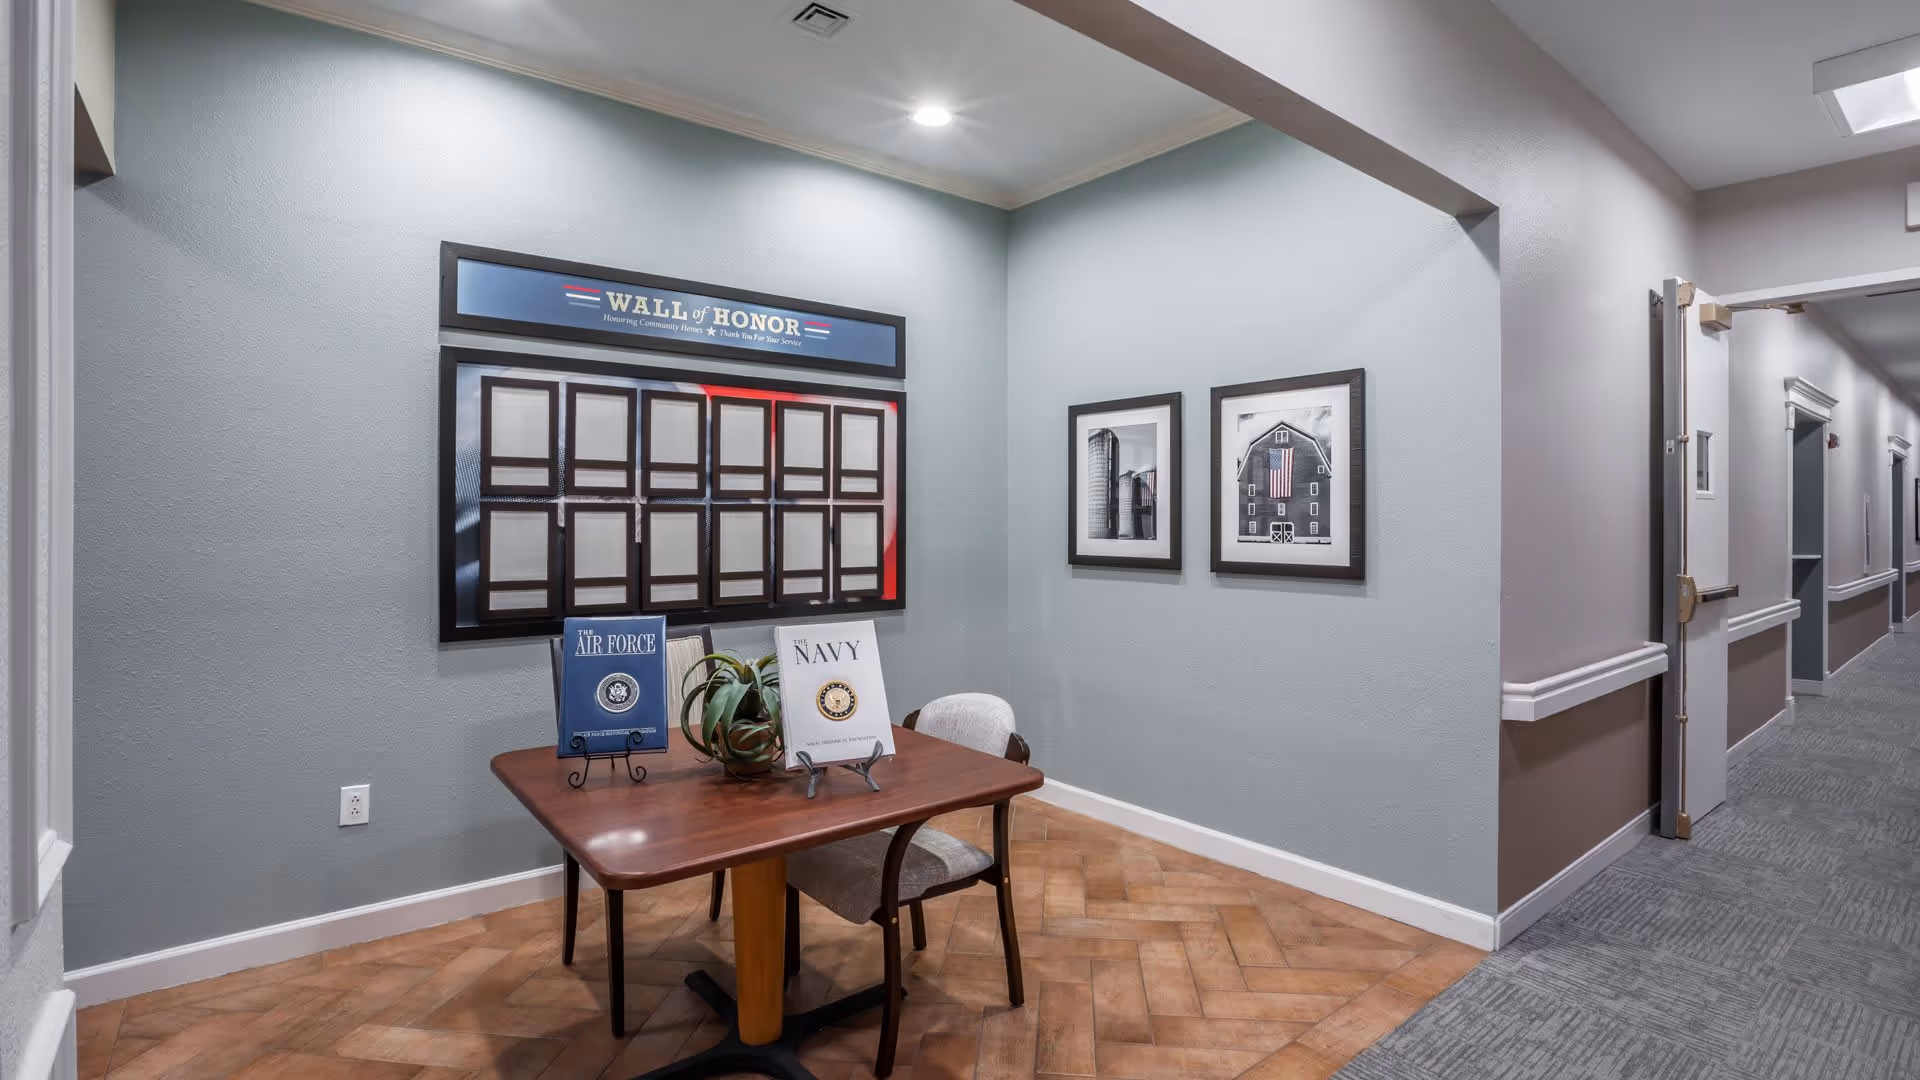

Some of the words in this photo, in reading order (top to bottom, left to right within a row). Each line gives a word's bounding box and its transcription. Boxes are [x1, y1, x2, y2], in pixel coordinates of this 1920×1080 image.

[603, 313, 638, 327] Honoring
[639, 319, 680, 333] Community
[681, 324, 703, 334] Heroes
[605, 291, 688, 320] WALL
[692, 306, 710, 324] of
[713, 307, 801, 336] HONOR
[720, 329, 740, 339] Thank
[742, 332, 753, 341] You
[753, 333, 765, 342] For
[766, 335, 780, 344] Your
[780, 338, 803, 348] Service
[575, 635, 603, 655] AIR
[607, 633, 656, 653] FORCE
[793, 638, 808, 646] THE
[794, 640, 861, 665] NAVY
